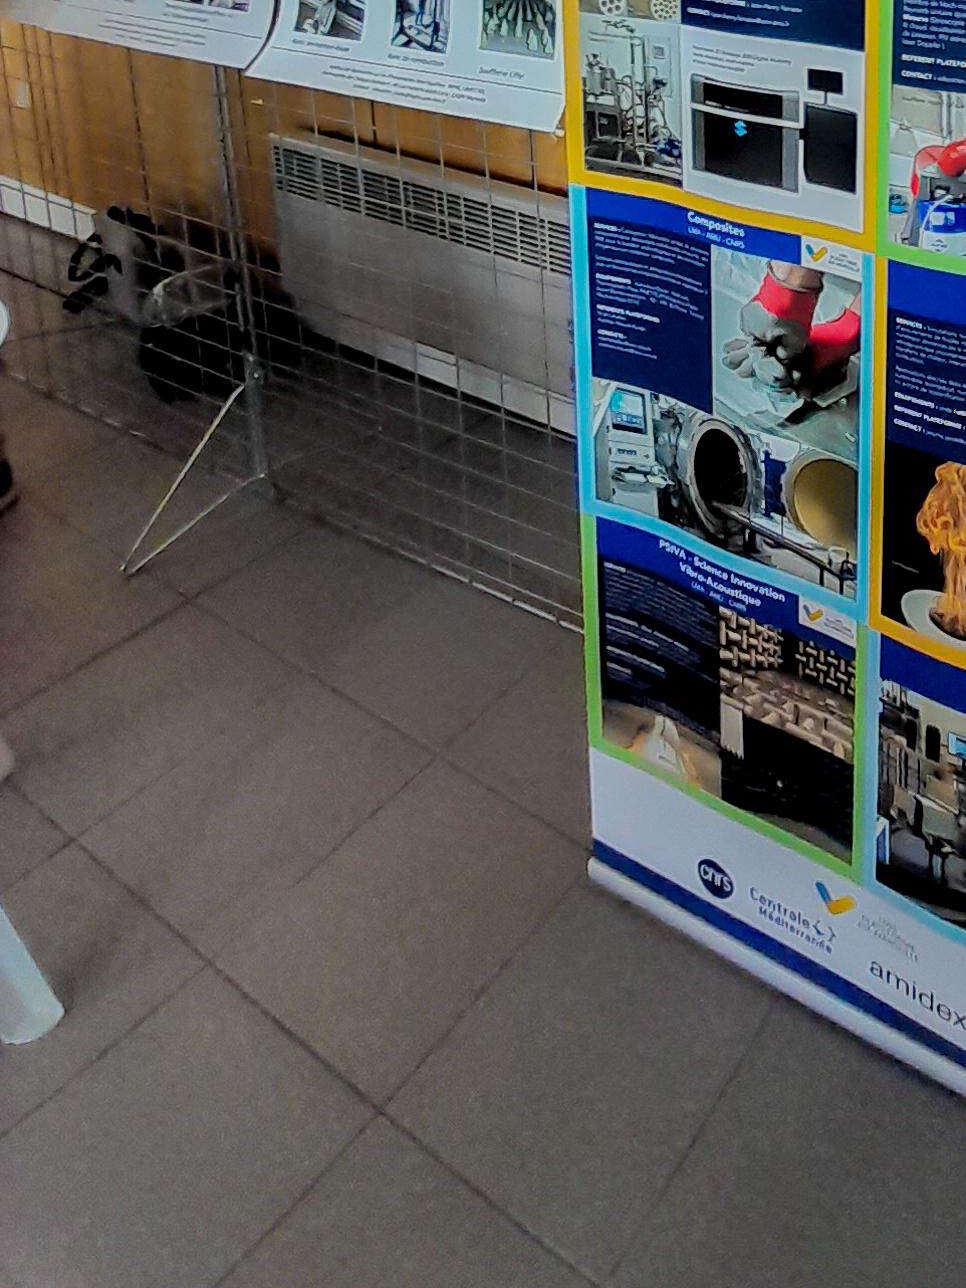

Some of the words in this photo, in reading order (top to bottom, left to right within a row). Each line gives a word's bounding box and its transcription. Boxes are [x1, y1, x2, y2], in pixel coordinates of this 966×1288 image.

[687, 211, 746, 238] Composites
[679, 561, 762, 607] Vibro-Acoustique
[693, 556, 729, 581] Science
[730, 573, 786, 603] Innovation
[749, 885, 811, 929] Centrale
[758, 906, 833, 955] Méditerranée
